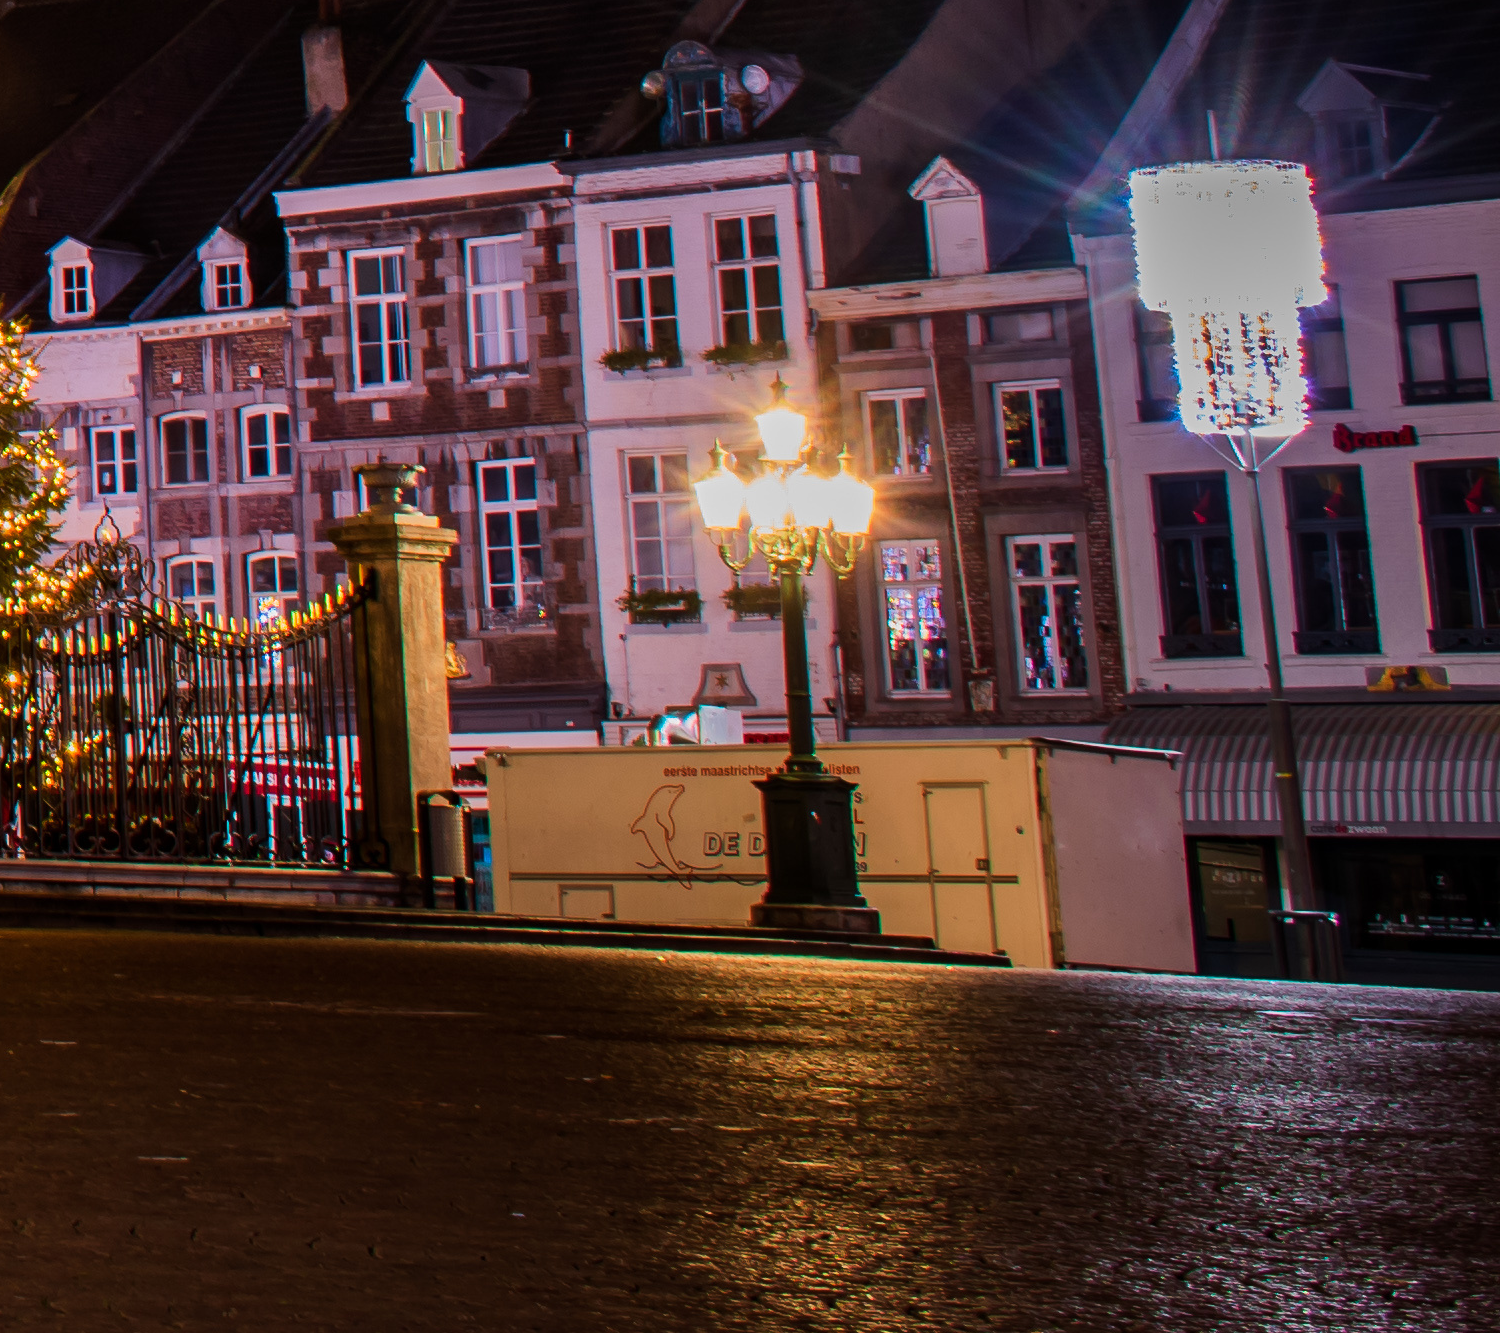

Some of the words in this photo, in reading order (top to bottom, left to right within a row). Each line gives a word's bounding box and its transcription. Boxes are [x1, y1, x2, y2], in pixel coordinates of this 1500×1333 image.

[1333, 423, 1417, 453] Brand
[663, 765, 698, 777] eerste
[700, 763, 772, 776] maastrichtse
[703, 831, 741, 858] DE
